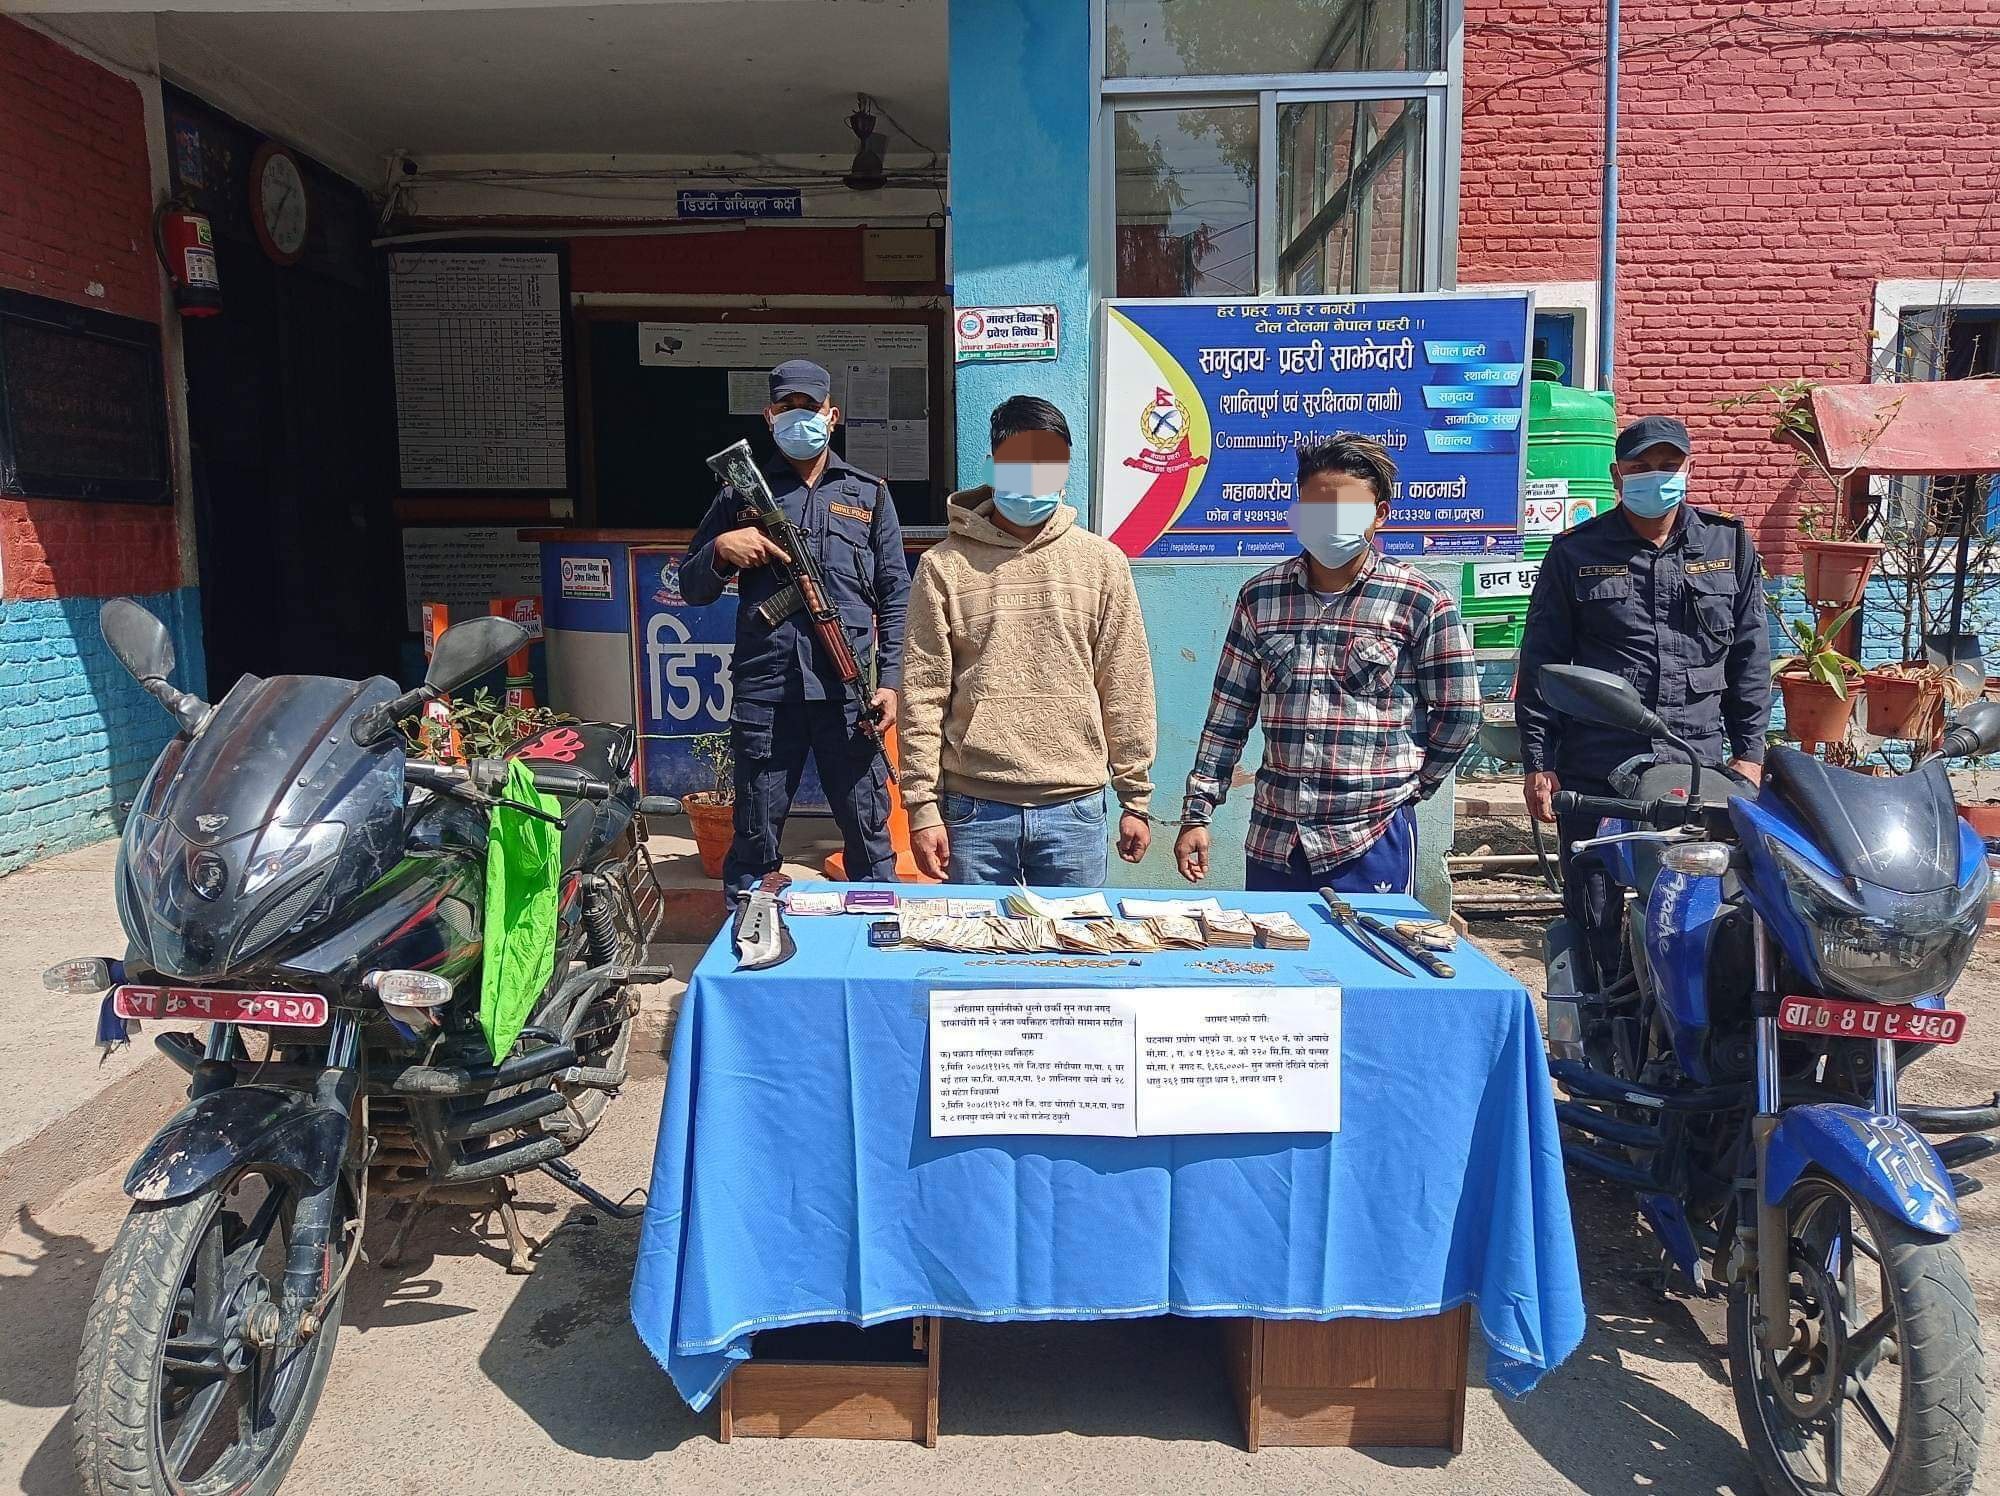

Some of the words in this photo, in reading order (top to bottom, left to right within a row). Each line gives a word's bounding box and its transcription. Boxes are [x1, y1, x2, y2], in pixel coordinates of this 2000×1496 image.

[683, 192, 719, 212] डिउटी
[724, 193, 767, 216] अधिकृत
[773, 196, 796, 212] कक्ष
[1216, 305, 1236, 318] हर
[1306, 305, 1316, 316] र
[1319, 302, 1357, 316] नगरी
[1255, 319, 1282, 333] टोल
[1286, 318, 1329, 333] टोलमा
[1333, 317, 1372, 332] नेपाल
[1376, 316, 1411, 332] प्रहरी
[1278, 338, 1325, 376] प्रहरी
[1329, 336, 1415, 372] साझेदारी
[1431, 344, 1459, 357] नेपाल
[1462, 343, 1487, 358] प्रहरी
[1463, 368, 1500, 382] स्थानीय
[1502, 370, 1518, 382] तह
[1219, 388, 1279, 419] (शान्तिपूर्ण
[1282, 390, 1299, 414] एवं
[1302, 387, 1363, 418] सुरक्षितका
[1366, 386, 1402, 413] लागी)
[1438, 391, 1475, 404] समुदाय
[1444, 411, 1489, 426] सामाजिक
[1491, 412, 1520, 425] संस्था
[1335, 428, 1408, 452] ership
[1434, 433, 1473, 447] विद्यालय
[1222, 478, 1293, 502] महानगरीय
[1205, 507, 1230, 523] फोन
[1479, 571, 1512, 589] हात
[646, 612, 736, 722] डिउ
[1656, 871, 1688, 956] Apache
[1077, 1019, 1101, 1027] सामान
